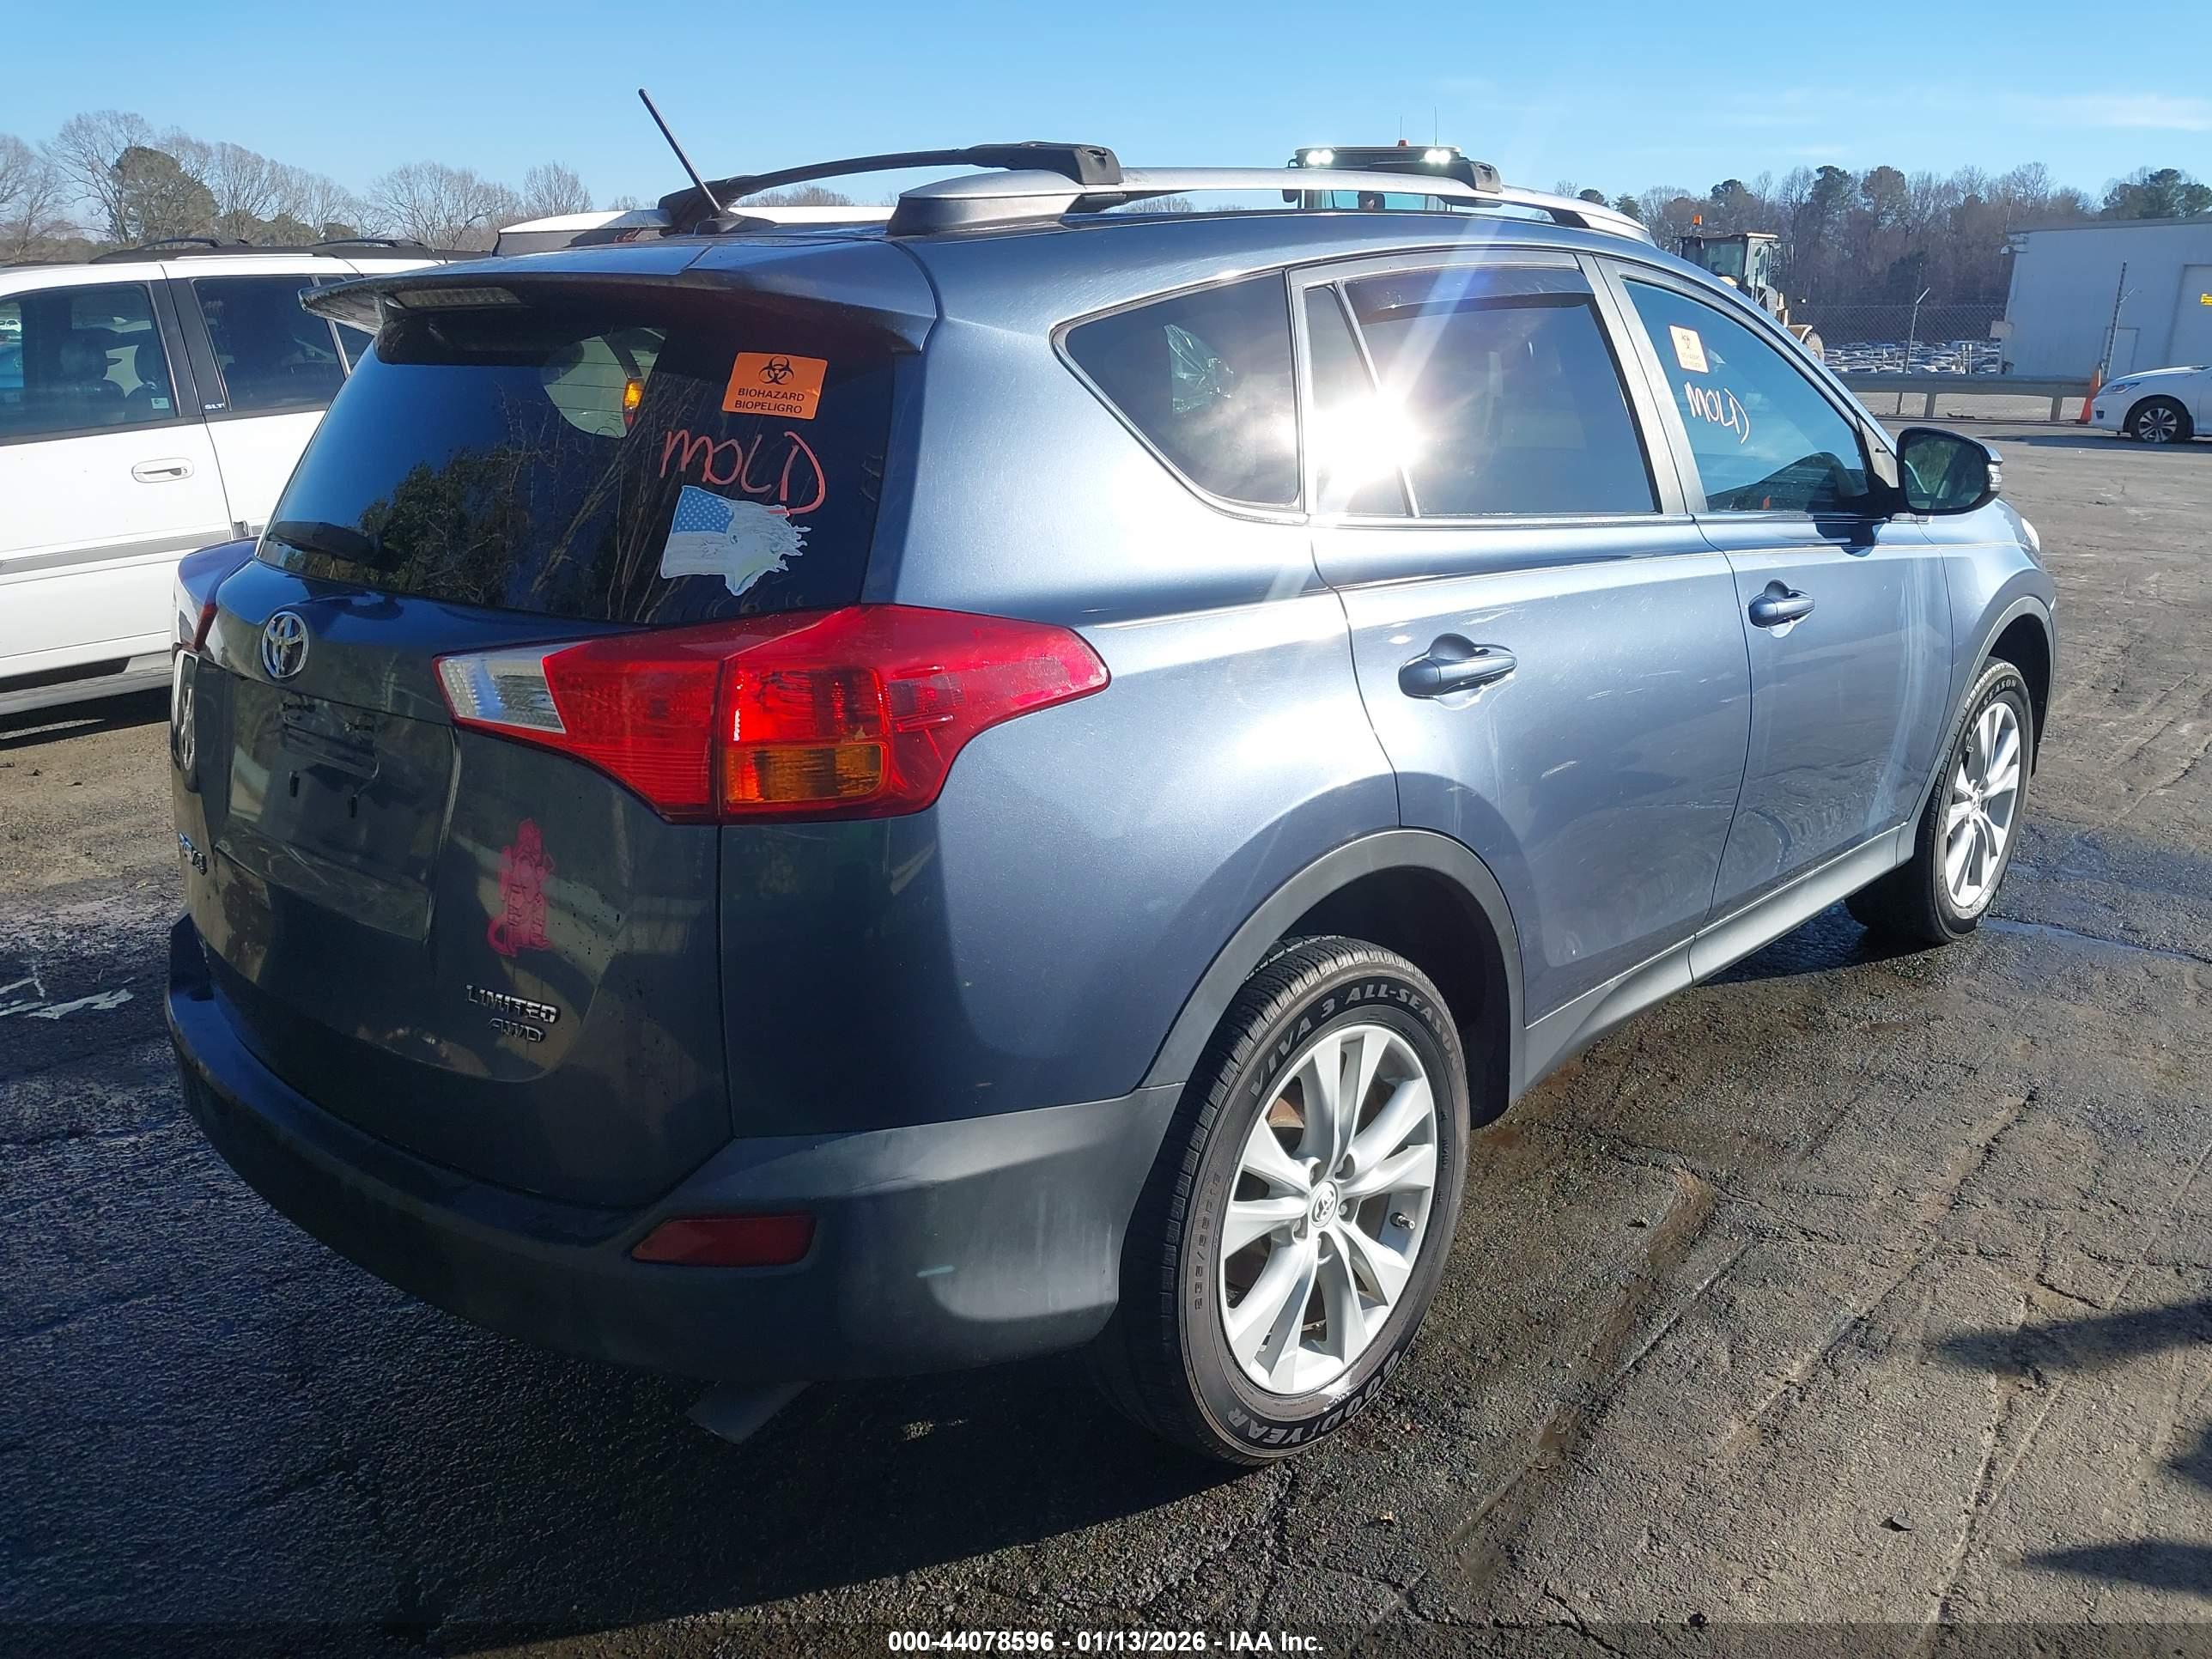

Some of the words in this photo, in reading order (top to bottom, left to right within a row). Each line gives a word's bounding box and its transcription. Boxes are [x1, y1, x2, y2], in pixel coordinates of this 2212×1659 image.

[734, 399, 803, 414] BIOPELIGRO
[738, 387, 805, 402] BIOHAZARD
[1684, 381, 1750, 445] MOLD
[659, 429, 826, 516] MOLD
[466, 984, 557, 1024] LIMITED
[488, 1018, 544, 1042] AWD
[1249, 1017, 1313, 1097] VIVA
[1321, 998, 1336, 1018] 3
[1345, 984, 1458, 1073] ALL-SEASON
